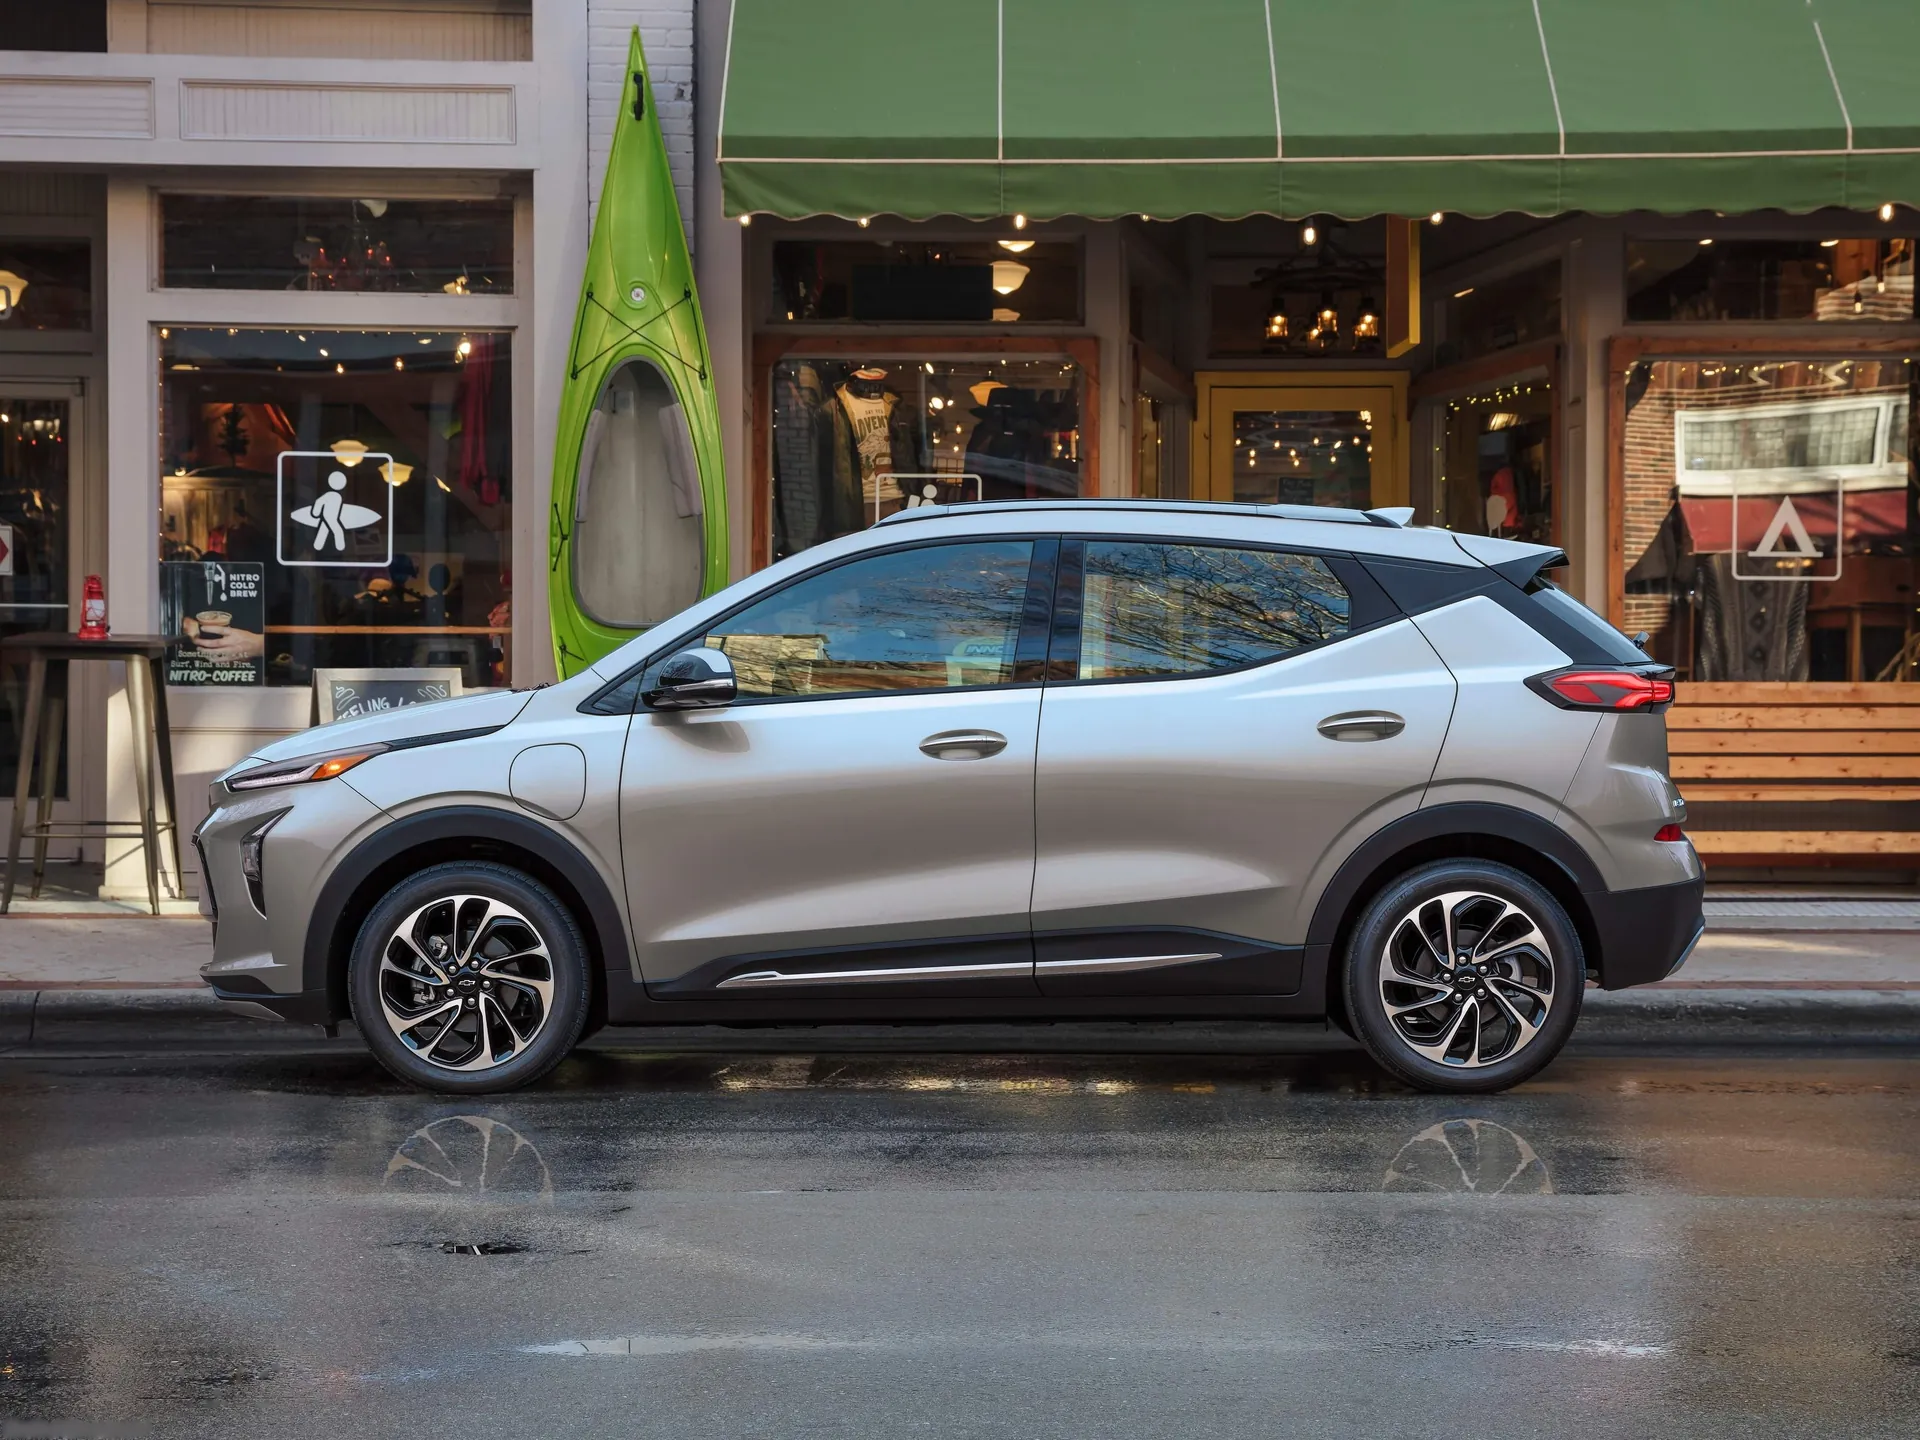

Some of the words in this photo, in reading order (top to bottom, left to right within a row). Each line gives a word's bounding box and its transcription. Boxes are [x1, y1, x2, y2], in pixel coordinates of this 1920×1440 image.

[230, 590, 257, 598] BREW
[170, 660, 193, 669] Surf,
[194, 660, 213, 668] Wind
[215, 660, 231, 668] and
[169, 670, 256, 682] NITRO-COFFEE
